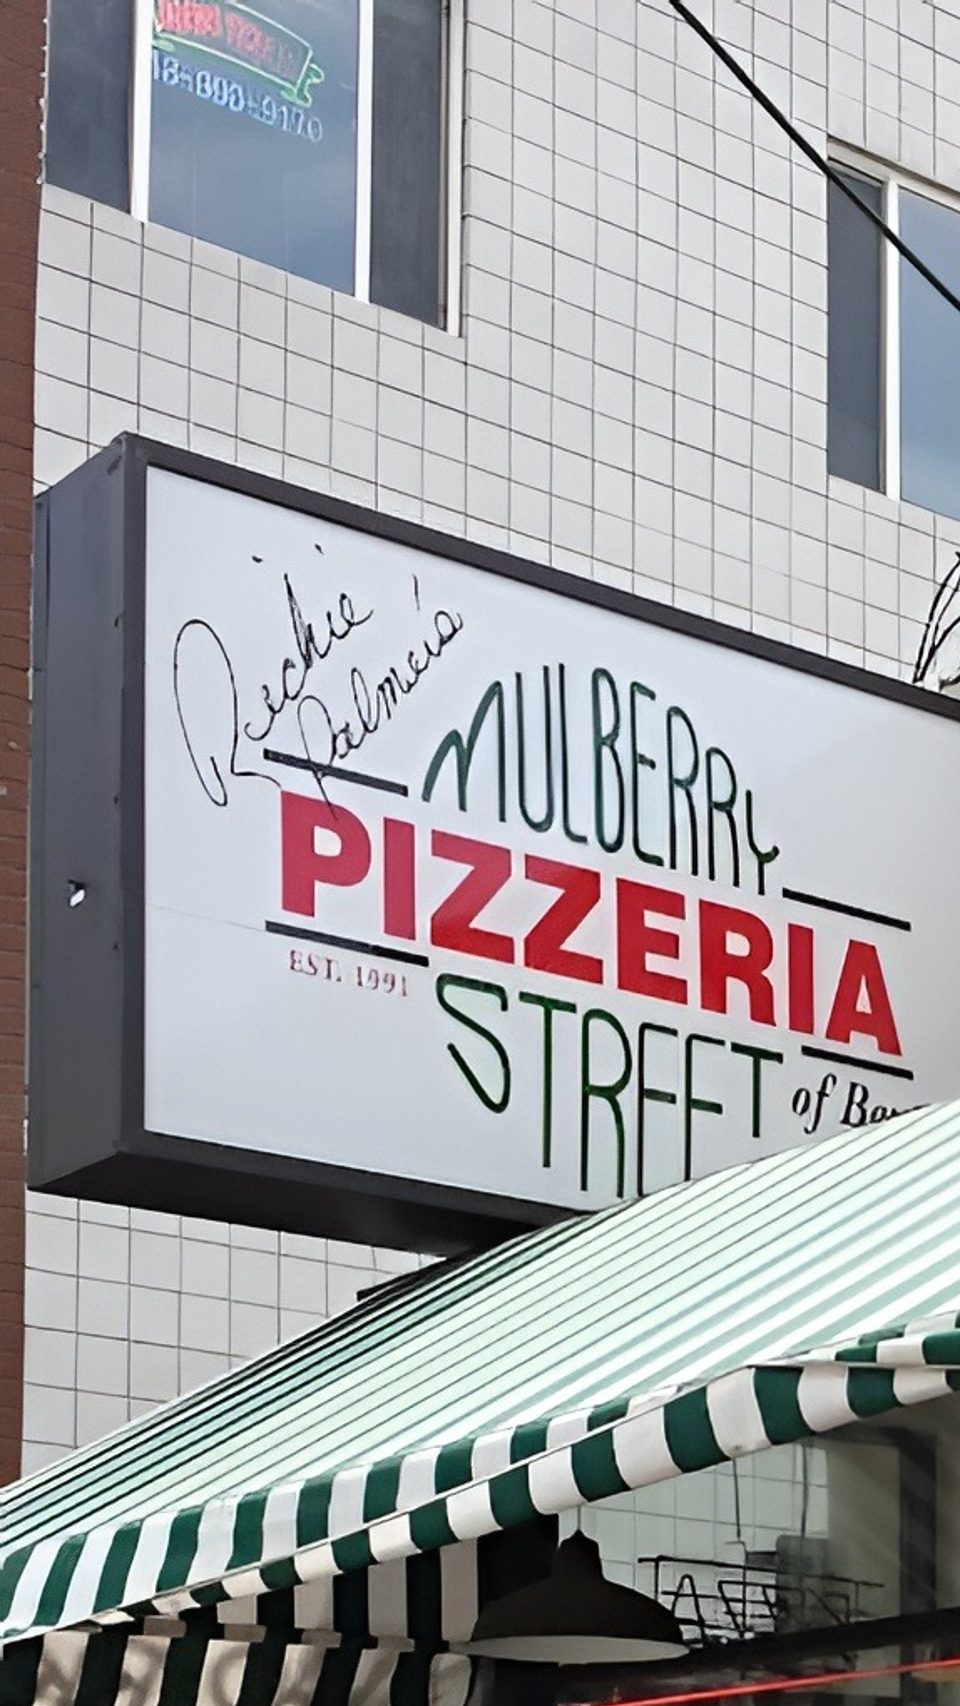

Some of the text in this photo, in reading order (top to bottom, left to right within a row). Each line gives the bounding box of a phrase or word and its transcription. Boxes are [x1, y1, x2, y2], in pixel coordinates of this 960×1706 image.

[421, 662, 780, 897] MULBERRY
[280, 790, 903, 1057] PIZZERIA
[289, 949, 408, 997] EST. 1991
[436, 974, 784, 1199] STREET
[791, 1072, 838, 1135] of
